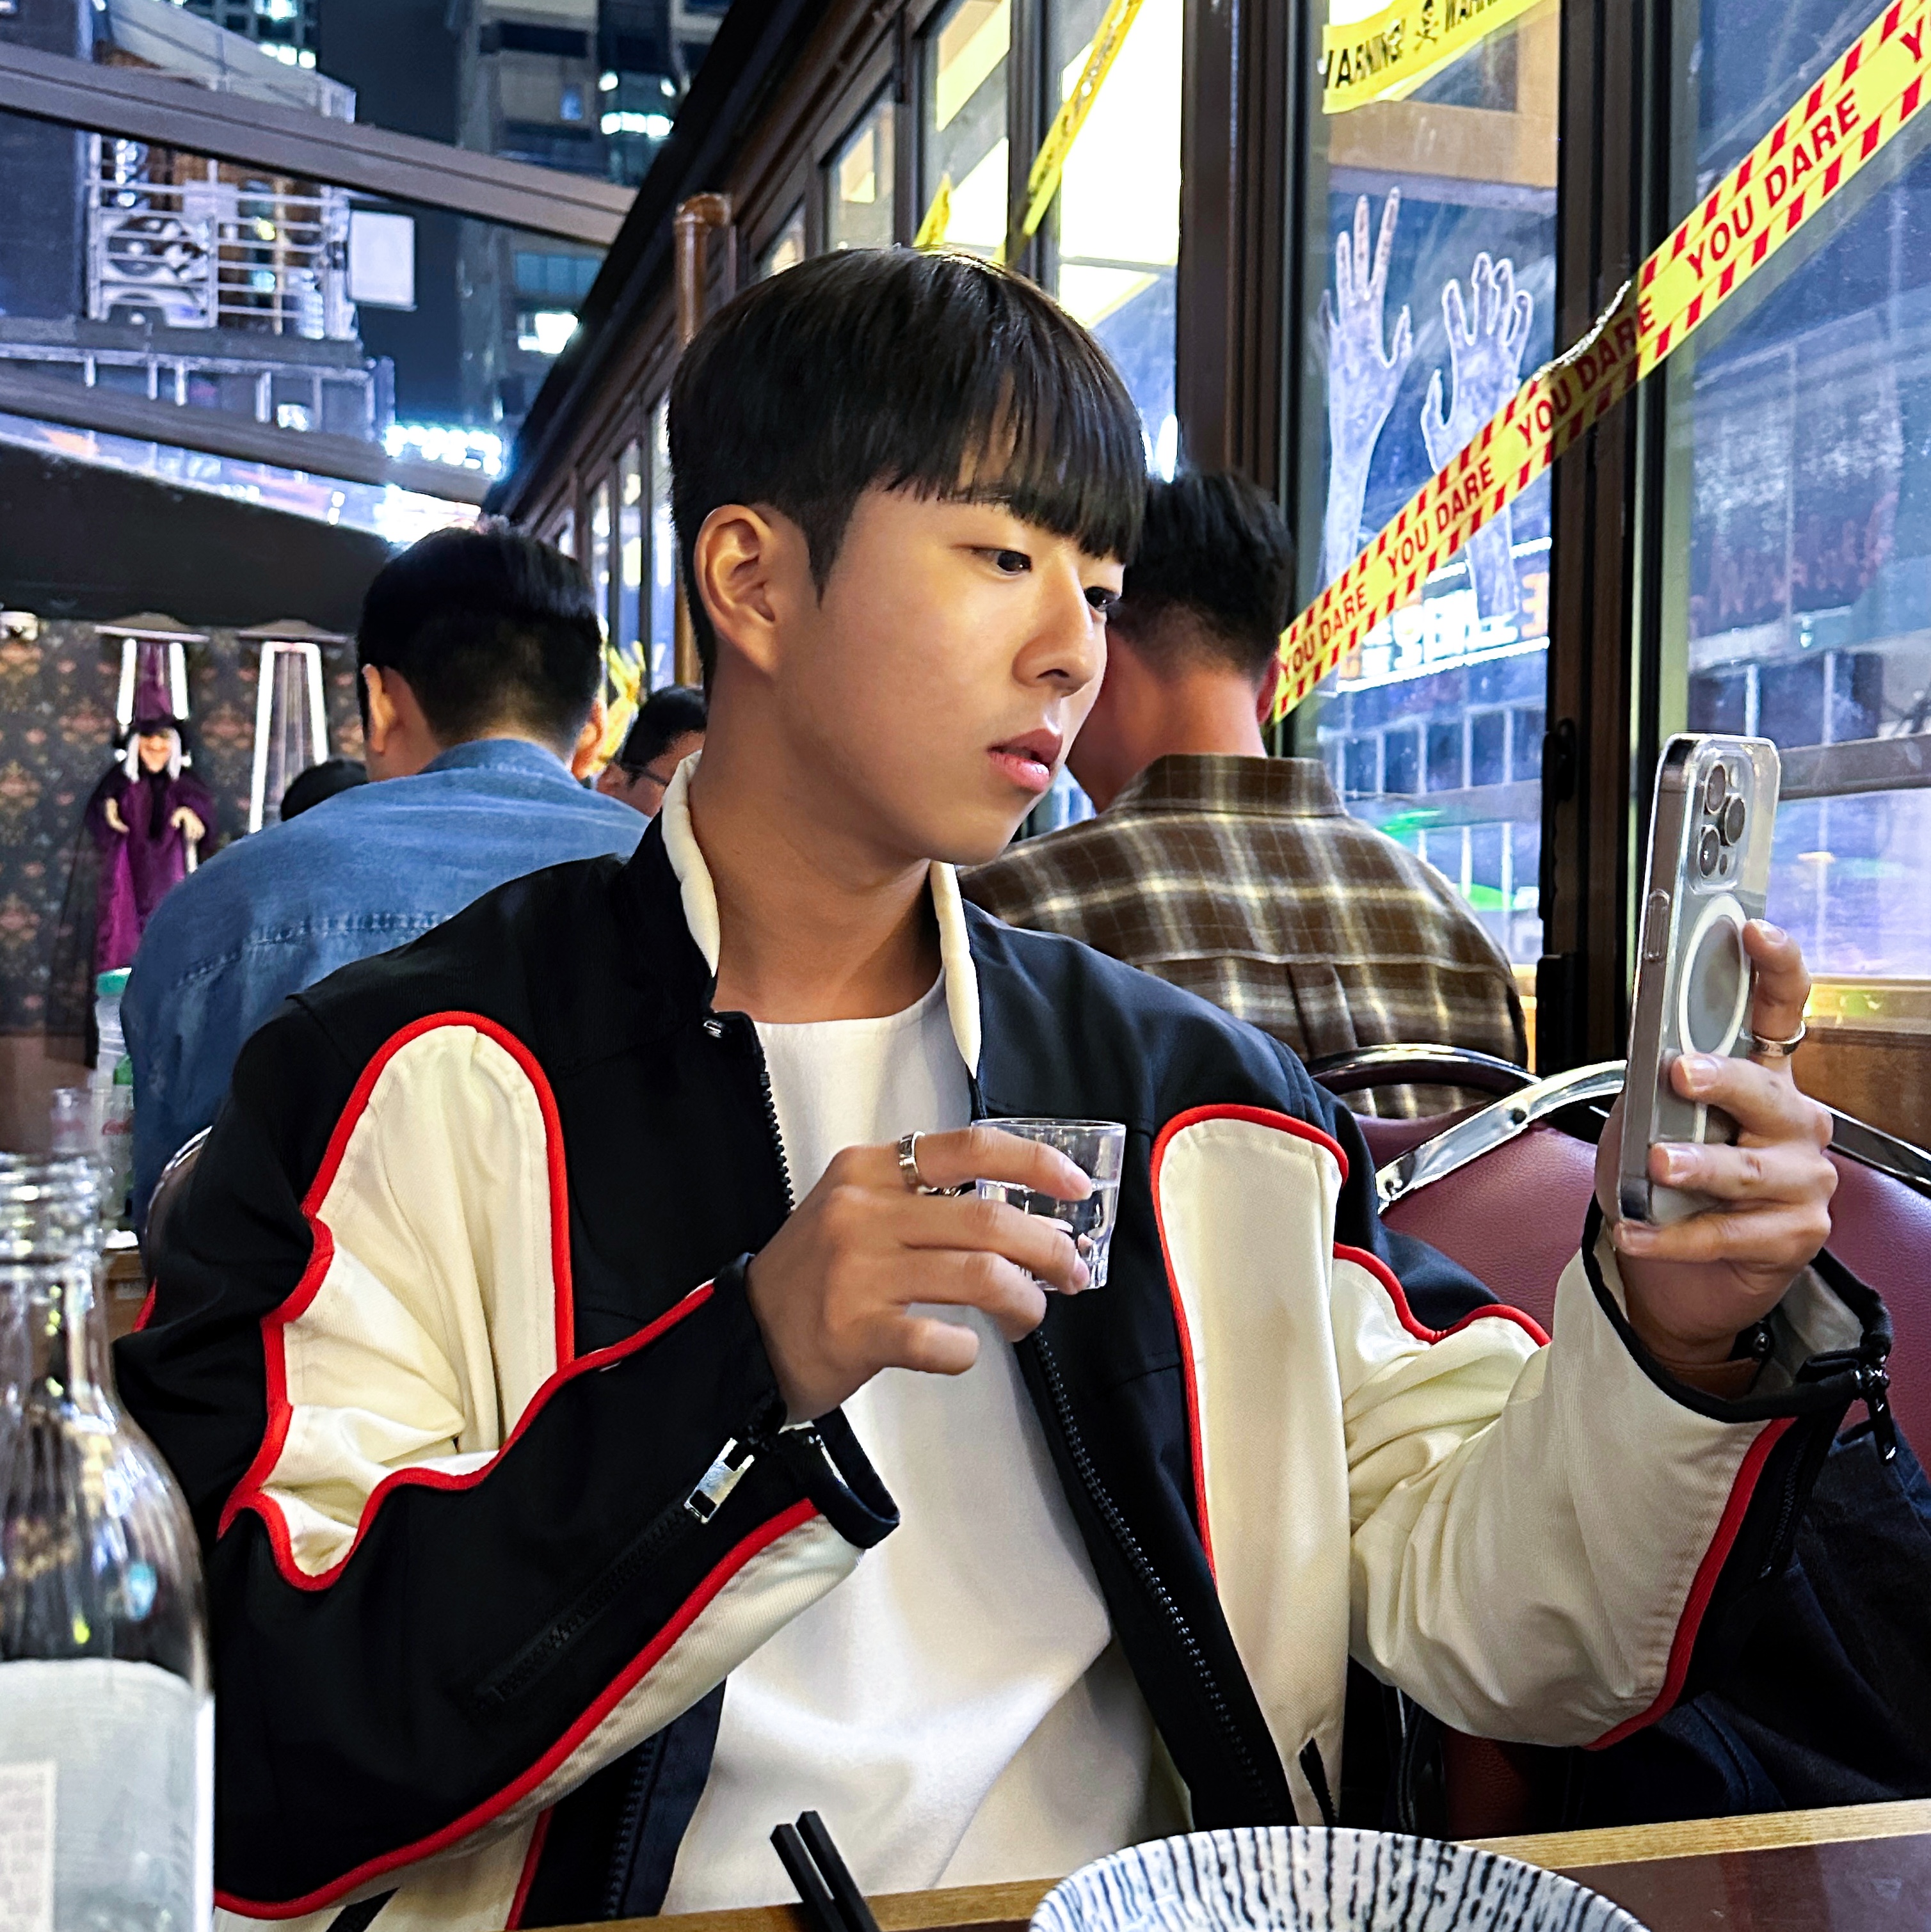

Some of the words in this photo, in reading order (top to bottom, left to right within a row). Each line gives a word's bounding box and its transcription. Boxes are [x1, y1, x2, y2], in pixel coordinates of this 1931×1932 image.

[1281, 633, 1315, 681] YOU
[1318, 582, 1367, 645] DARE
[1388, 520, 1429, 577] YOU
[1436, 457, 1494, 533] DARE
[1517, 378, 1572, 448] YOU
[1574, 296, 1655, 392] DARE
[1686, 194, 1753, 280] YOU
[1765, 88, 1861, 209] DARE
